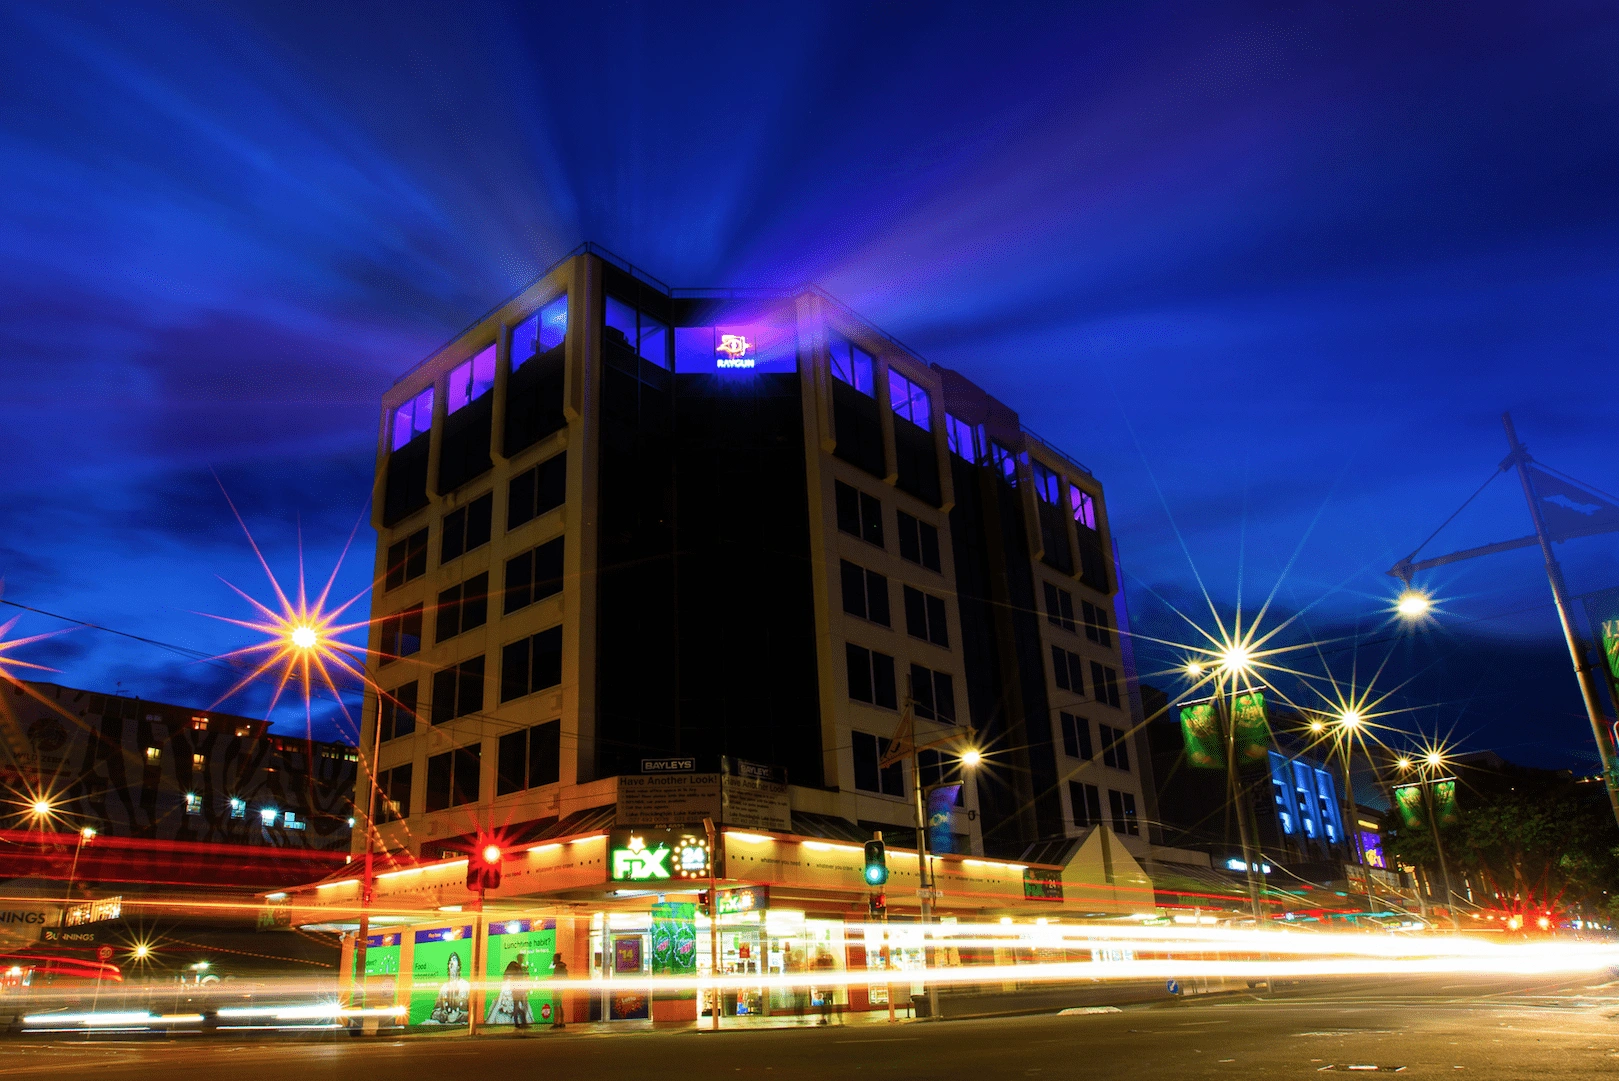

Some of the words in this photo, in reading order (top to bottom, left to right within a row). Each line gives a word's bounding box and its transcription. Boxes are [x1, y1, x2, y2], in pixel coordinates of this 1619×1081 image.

[717, 359, 754, 368] RAYGUN
[645, 761, 692, 770] BAYLEYS
[620, 776, 644, 786] Have
[648, 775, 686, 785] Another
[690, 774, 717, 784] Look!
